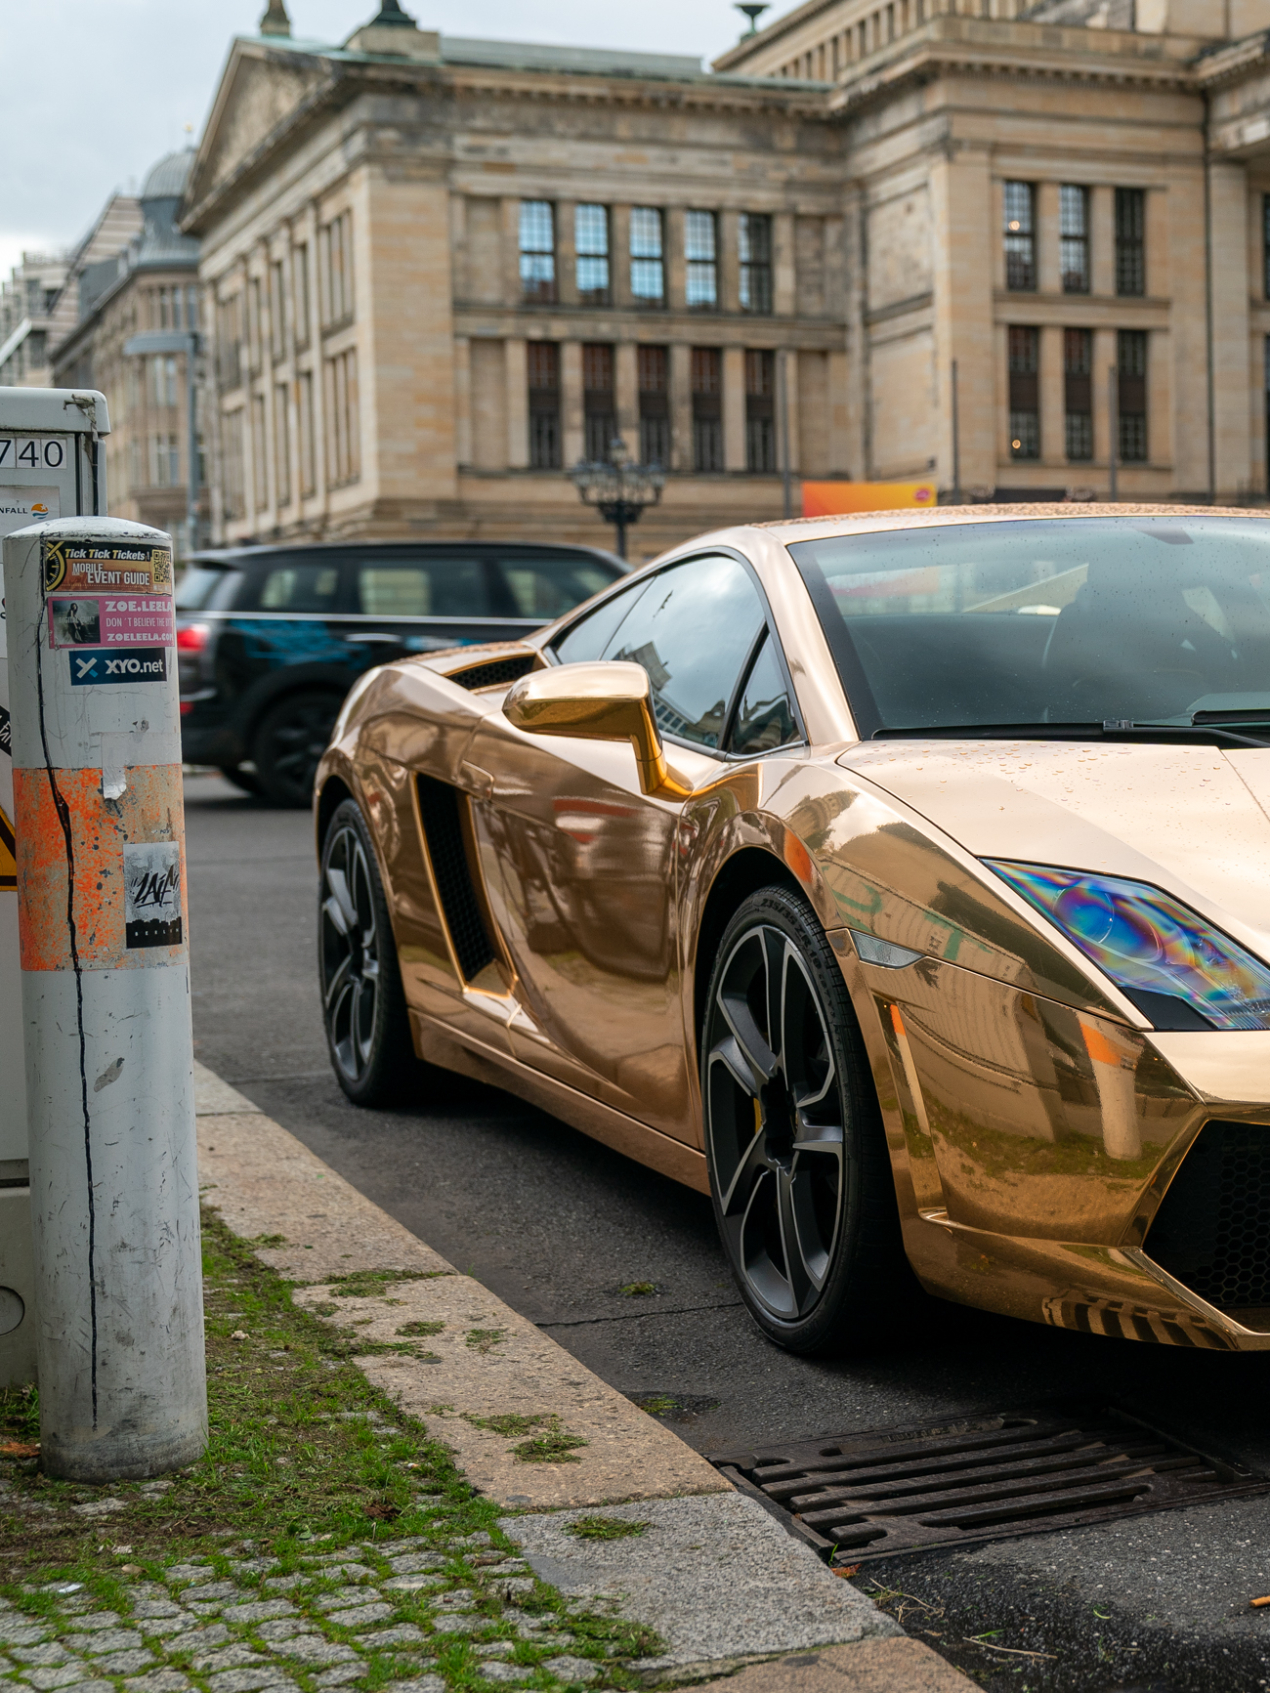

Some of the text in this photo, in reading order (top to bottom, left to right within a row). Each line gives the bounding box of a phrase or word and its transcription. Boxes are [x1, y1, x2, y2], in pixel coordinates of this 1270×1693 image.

[0, 440, 63, 467] 740
[65, 548, 86, 559] Tick
[89, 549, 110, 559] Tick
[72, 563, 104, 573] MOBILE
[87, 571, 150, 585] EVENT GUIDE
[105, 600, 172, 612] ZOE.LEELA
[134, 617, 156, 627] BELIEVE
[104, 658, 164, 675] XYO.net
